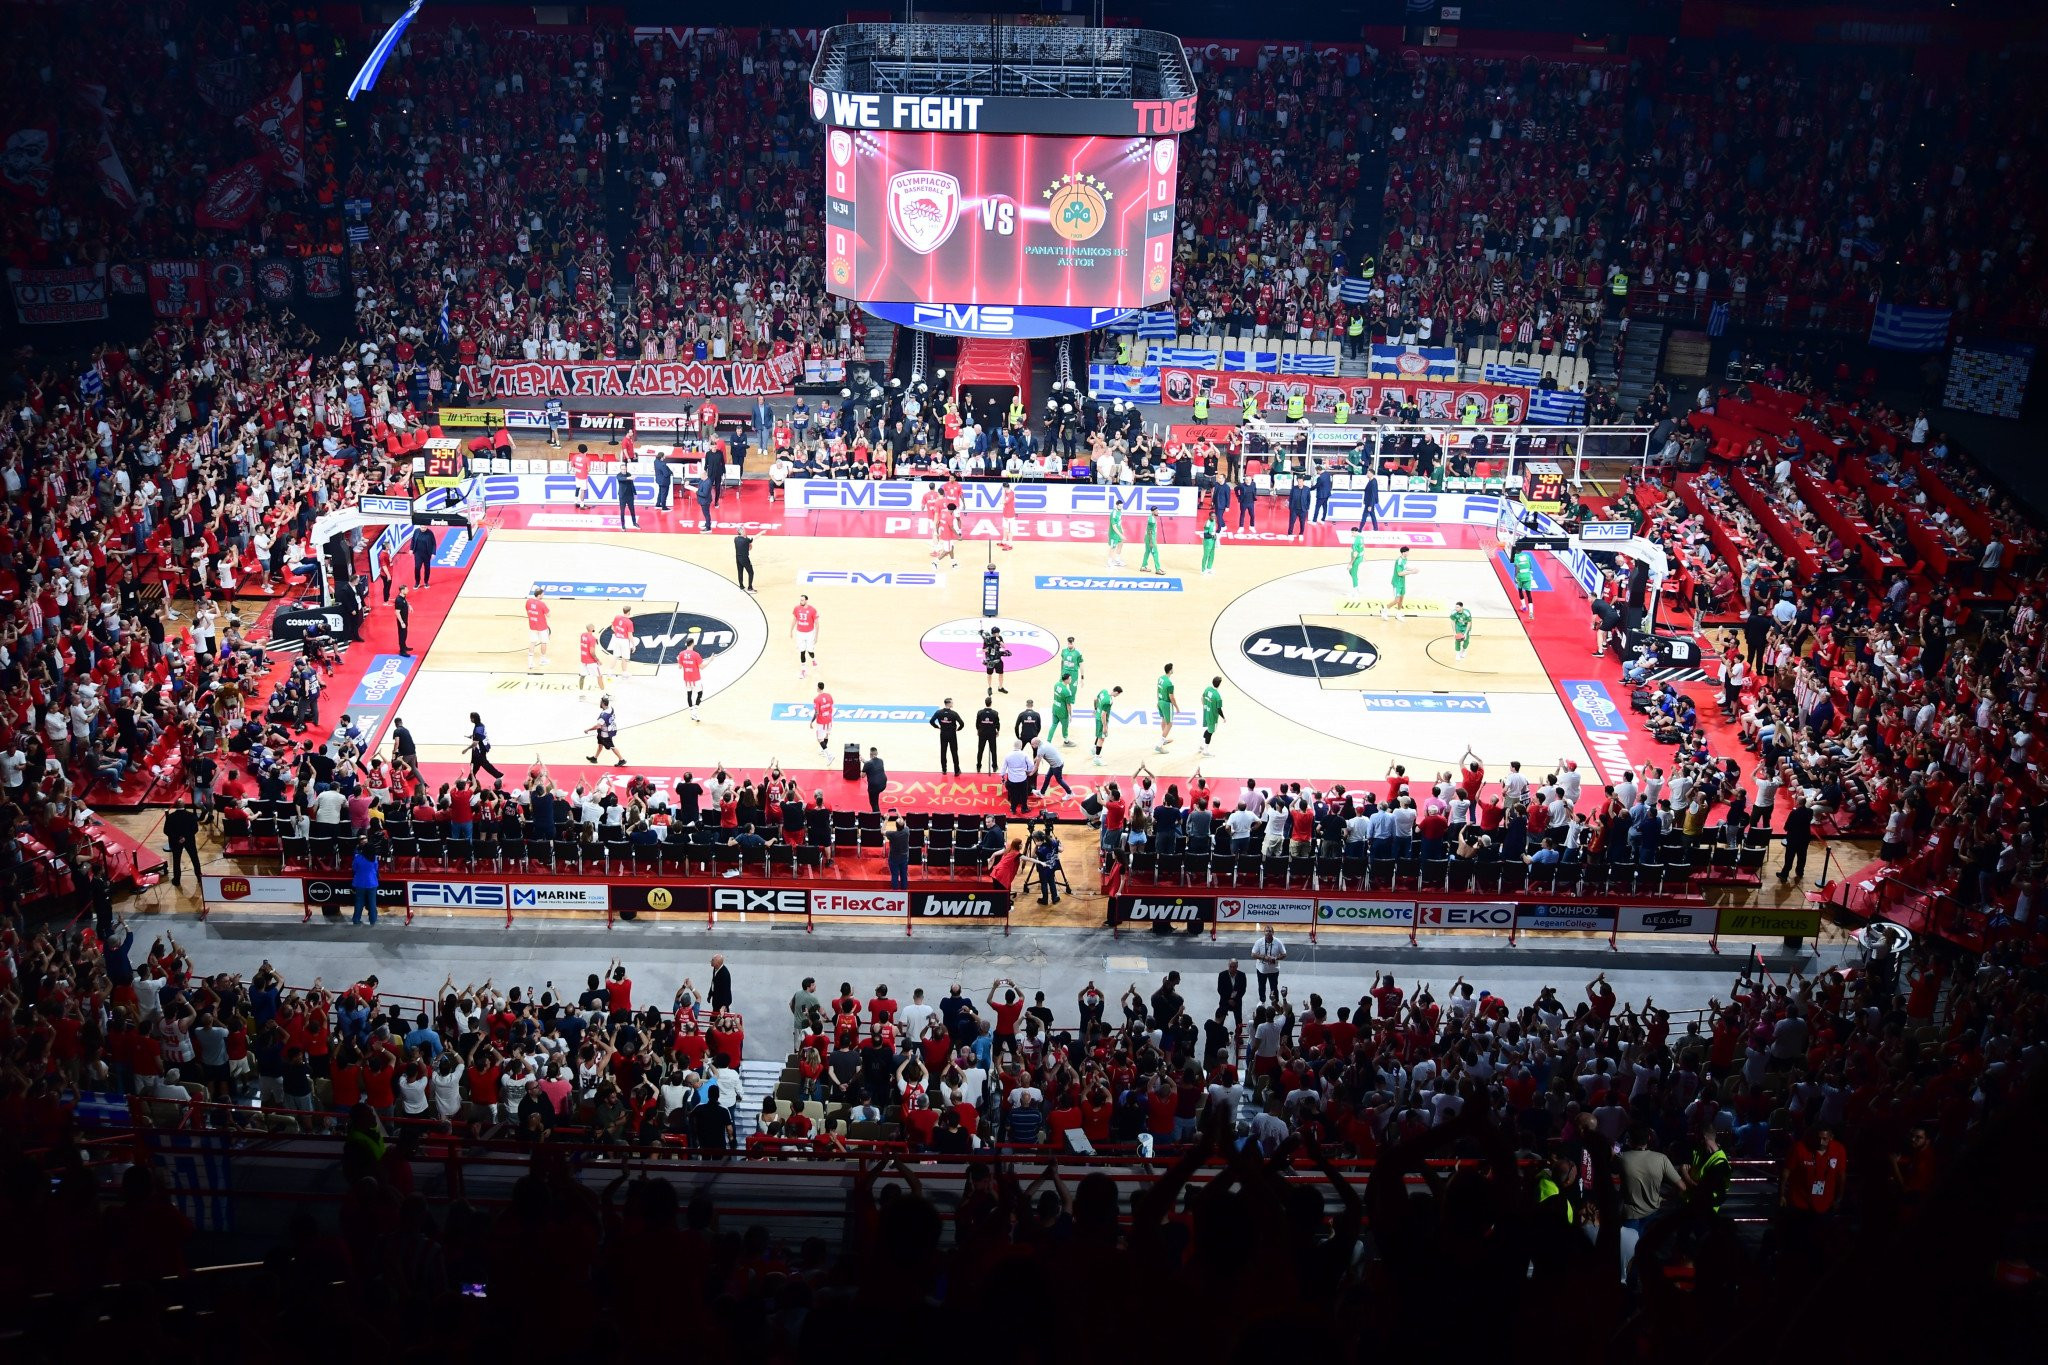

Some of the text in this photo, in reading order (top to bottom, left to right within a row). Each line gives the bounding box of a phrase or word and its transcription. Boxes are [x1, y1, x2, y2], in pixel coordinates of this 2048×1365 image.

[832, 92, 983, 130] WE FIGHT
[836, 171, 846, 193] 0
[896, 177, 952, 190] OLYMPIACOS
[903, 186, 945, 196] BASKETBALL
[1157, 180, 1167, 201] 0
[982, 198, 1015, 235] VS
[836, 233, 846, 256] 0
[1024, 246, 1112, 258] PANATHINAIKOS
[1154, 241, 1163, 263] 0
[1057, 257, 1095, 268] AKTOR
[913, 303, 1014, 332] FMS
[573, 362, 624, 395] ΣΤΑ
[628, 361, 729, 396] ΑΔΕΡΦΙΑ
[581, 412, 626, 429] bwin
[429, 459, 453, 475] 24
[544, 476, 656, 501] FMS
[804, 481, 912, 507] FMS
[1532, 485, 1558, 500] 24
[363, 499, 410, 512] FMS
[1071, 486, 1180, 511] FMS
[885, 517, 1097, 539] PIAEUS
[1584, 525, 1629, 536] FMS
[1567, 547, 1598, 592] MS
[806, 571, 936, 586] FMS
[1042, 575, 1171, 590] Stoiximan
[606, 586, 646, 595] PAY
[939, 628, 1041, 639] COSOTE
[1247, 637, 1378, 671] bwin
[1363, 698, 1487, 709] NBG PAY
[223, 880, 248, 893] alfa
[376, 888, 404, 897] QUIT
[411, 884, 504, 905] FMS
[537, 890, 587, 900] MARINE
[653, 892, 667, 903] M
[714, 889, 806, 913] AXE
[831, 895, 906, 912] FlexCar
[922, 893, 992, 917] bwin
[1129, 898, 1199, 921] bwin
[1549, 905, 1599, 916] ΟΜΗΡΟΣ
[1335, 906, 1413, 920] COSMOTE
[1447, 908, 1512, 925] EKO
[1645, 916, 1689, 925] ΔΕΔΔΗΕ
[1533, 919, 1597, 929] AegeanCollege
[1751, 915, 1808, 931] Piraeus
